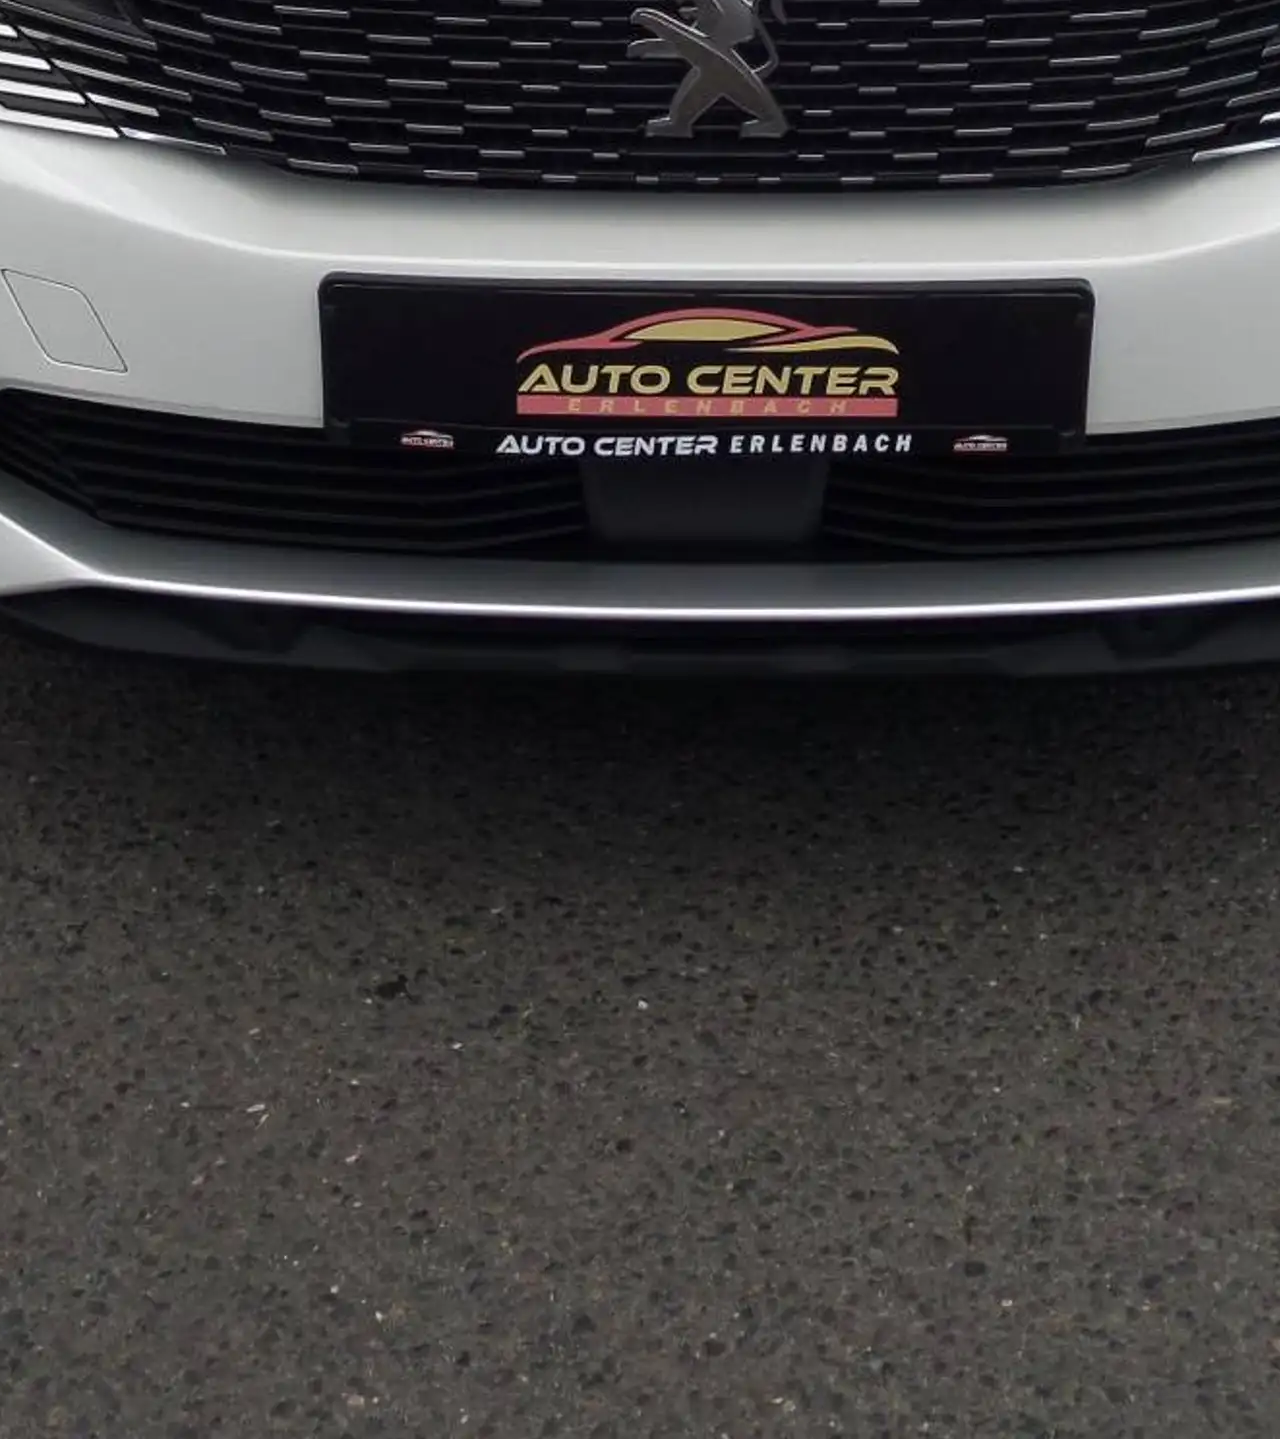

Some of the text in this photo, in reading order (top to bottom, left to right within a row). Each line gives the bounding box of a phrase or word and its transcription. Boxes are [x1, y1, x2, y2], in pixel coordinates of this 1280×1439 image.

[517, 363, 900, 396] AUTO CENTER
[567, 398, 849, 414] ERLENBACH
[495, 433, 913, 457] AUTO CENTER ERLENBACH
